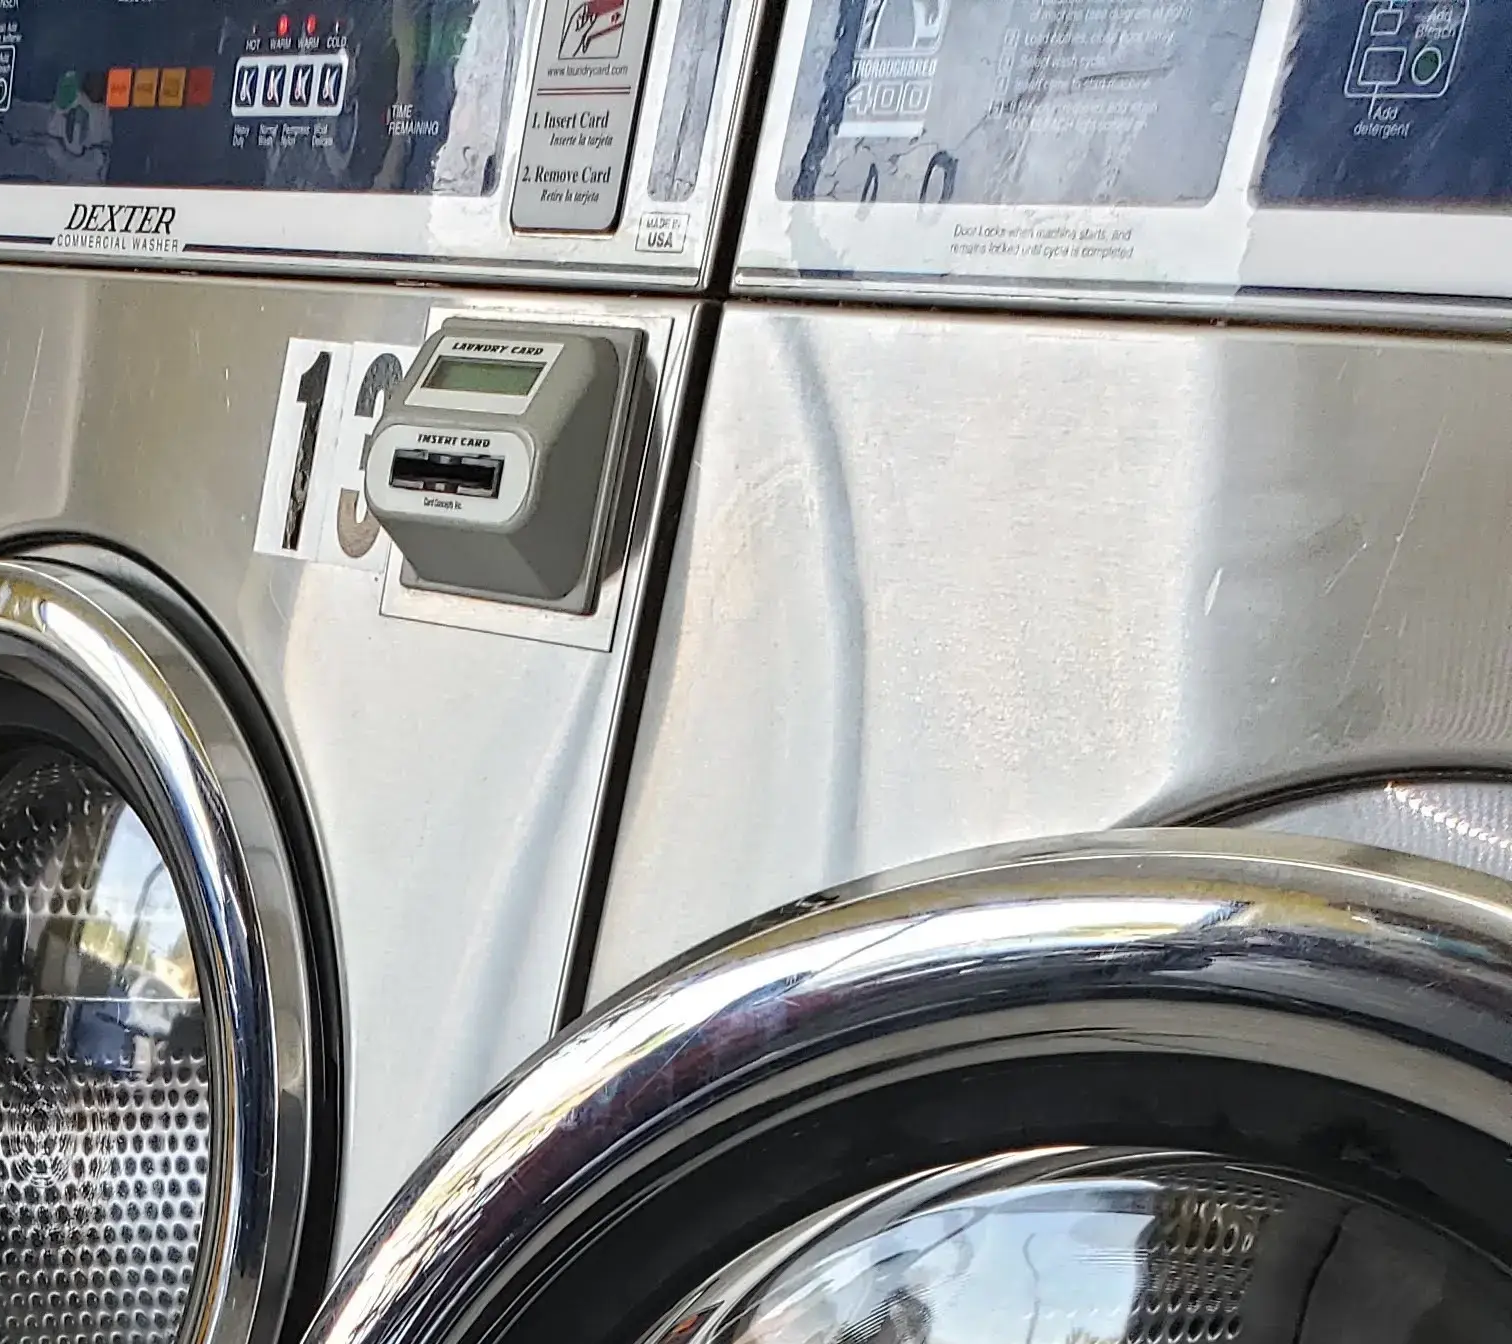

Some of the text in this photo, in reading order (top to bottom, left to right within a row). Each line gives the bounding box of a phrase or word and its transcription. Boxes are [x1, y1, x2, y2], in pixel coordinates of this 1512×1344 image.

[246, 39, 261, 50] HOT
[269, 37, 292, 49] WARM
[298, 37, 320, 49] WARM
[326, 36, 347, 49] COLD
[547, 62, 628, 78] www.laundrycard.com
[845, 79, 932, 115] 400
[391, 104, 414, 118] TIME
[532, 109, 610, 129] 1. Insert Card
[1373, 105, 1399, 121] Add
[388, 121, 439, 136] REMAINING
[1353, 121, 1412, 139] detergent
[550, 132, 614, 149] Inserte la tarjeta
[522, 165, 612, 183] 2. Remove Card
[540, 189, 600, 205] Retire la tarjeta
[64, 203, 176, 235] DEXTER
[57, 234, 179, 253] COMMERCIAL WASHER
[647, 231, 673, 248] USA
[452, 342, 544, 356] LAUNDRY CARD
[417, 433, 491, 448] INSERT CARD
